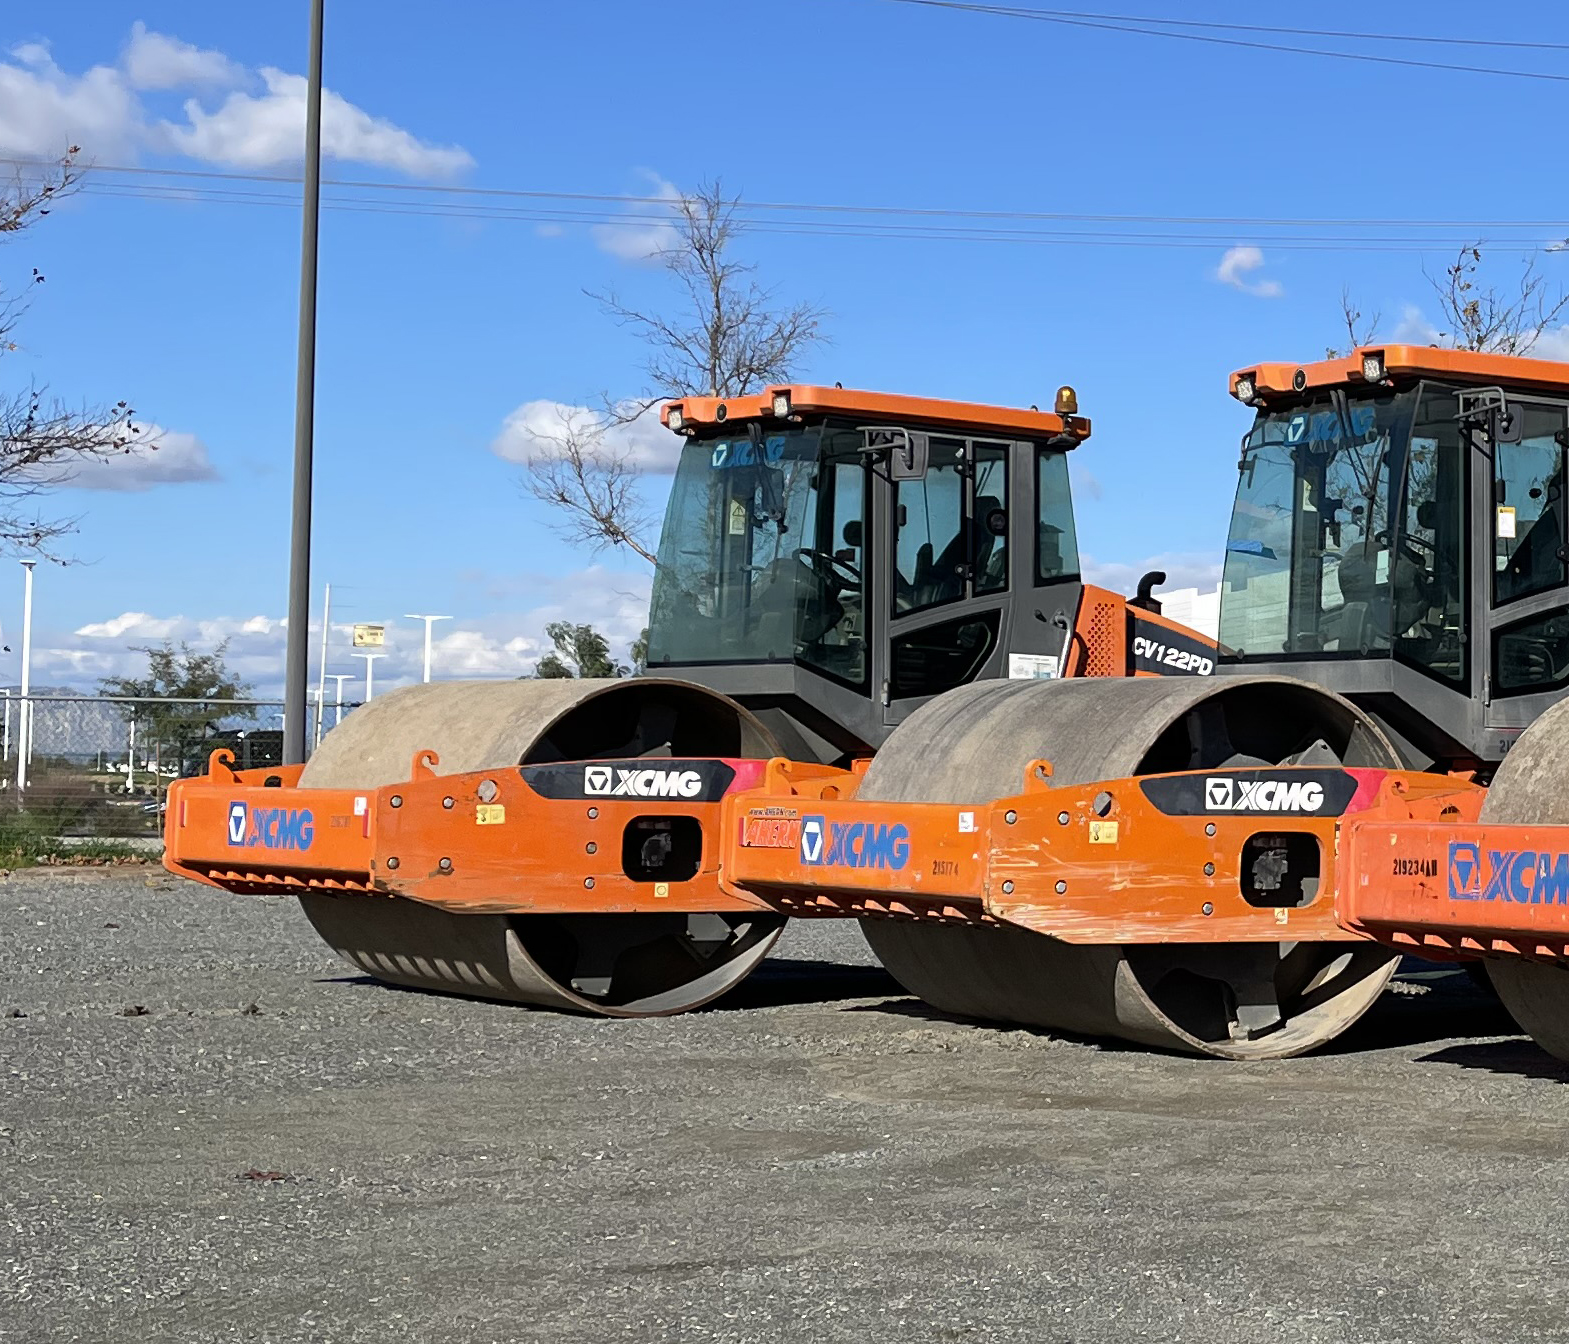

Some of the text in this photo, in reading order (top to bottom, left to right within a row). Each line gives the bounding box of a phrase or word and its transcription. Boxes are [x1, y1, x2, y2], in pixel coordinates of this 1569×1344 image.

[1132, 636, 1214, 676] CV122PD
[610, 769, 702, 798] XCMG
[1231, 781, 1325, 812] XCMG
[245, 807, 315, 852] XCMG
[823, 821, 913, 871] XCMG
